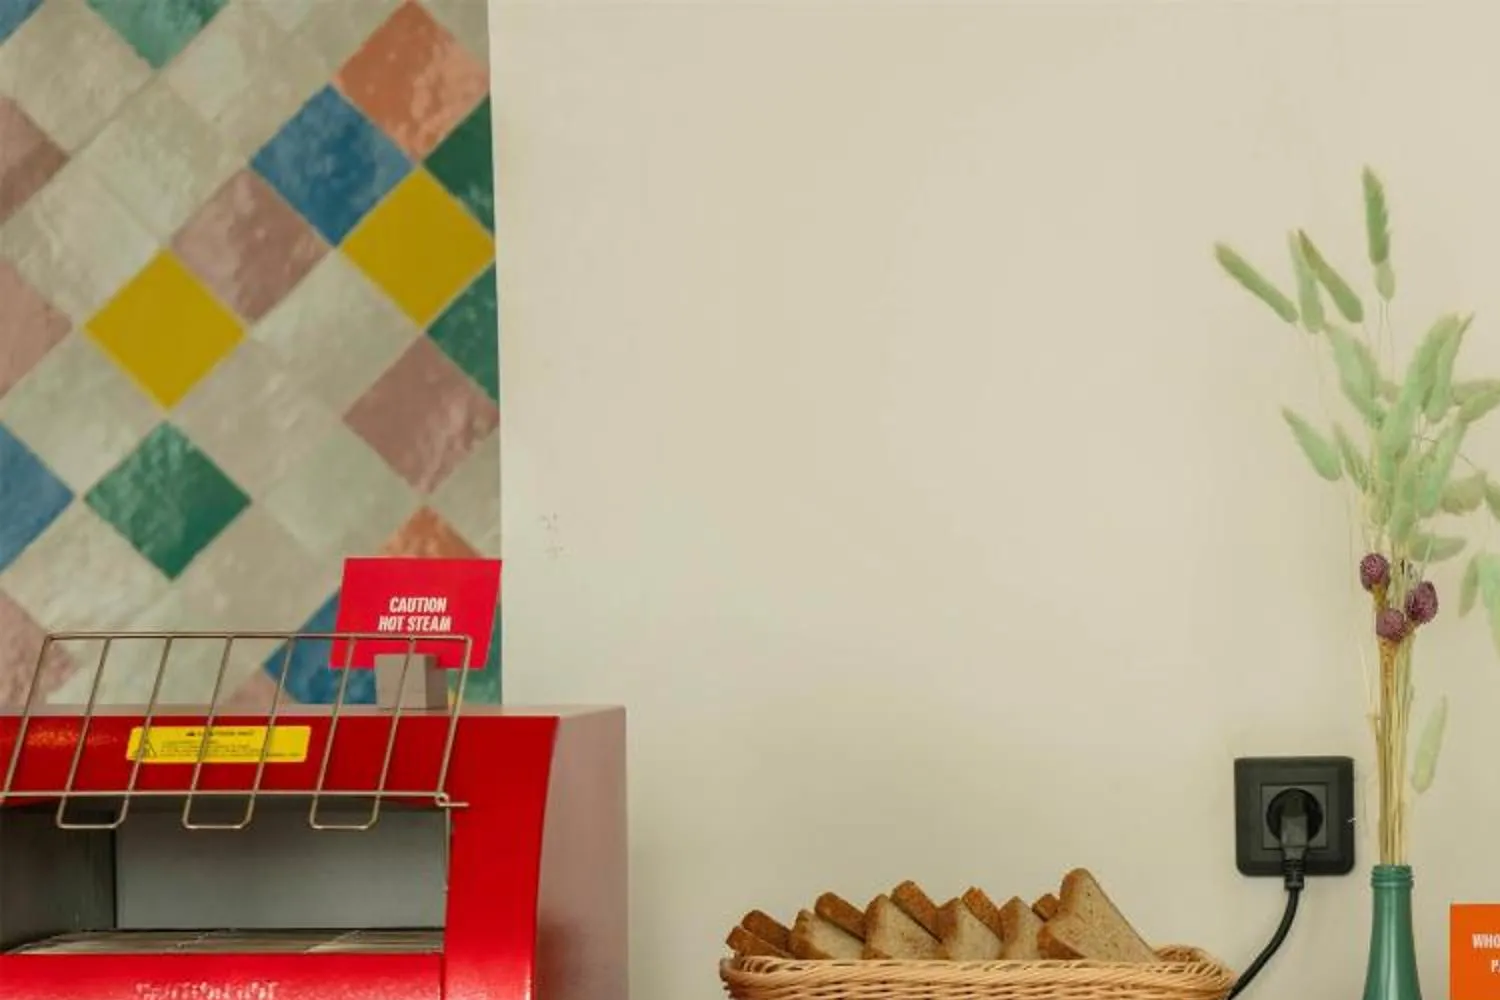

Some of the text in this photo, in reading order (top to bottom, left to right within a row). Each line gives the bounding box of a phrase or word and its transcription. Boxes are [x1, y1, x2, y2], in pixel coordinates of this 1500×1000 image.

[389, 596, 447, 613] CAUTION
[378, 615, 452, 632] HOT STEAM
